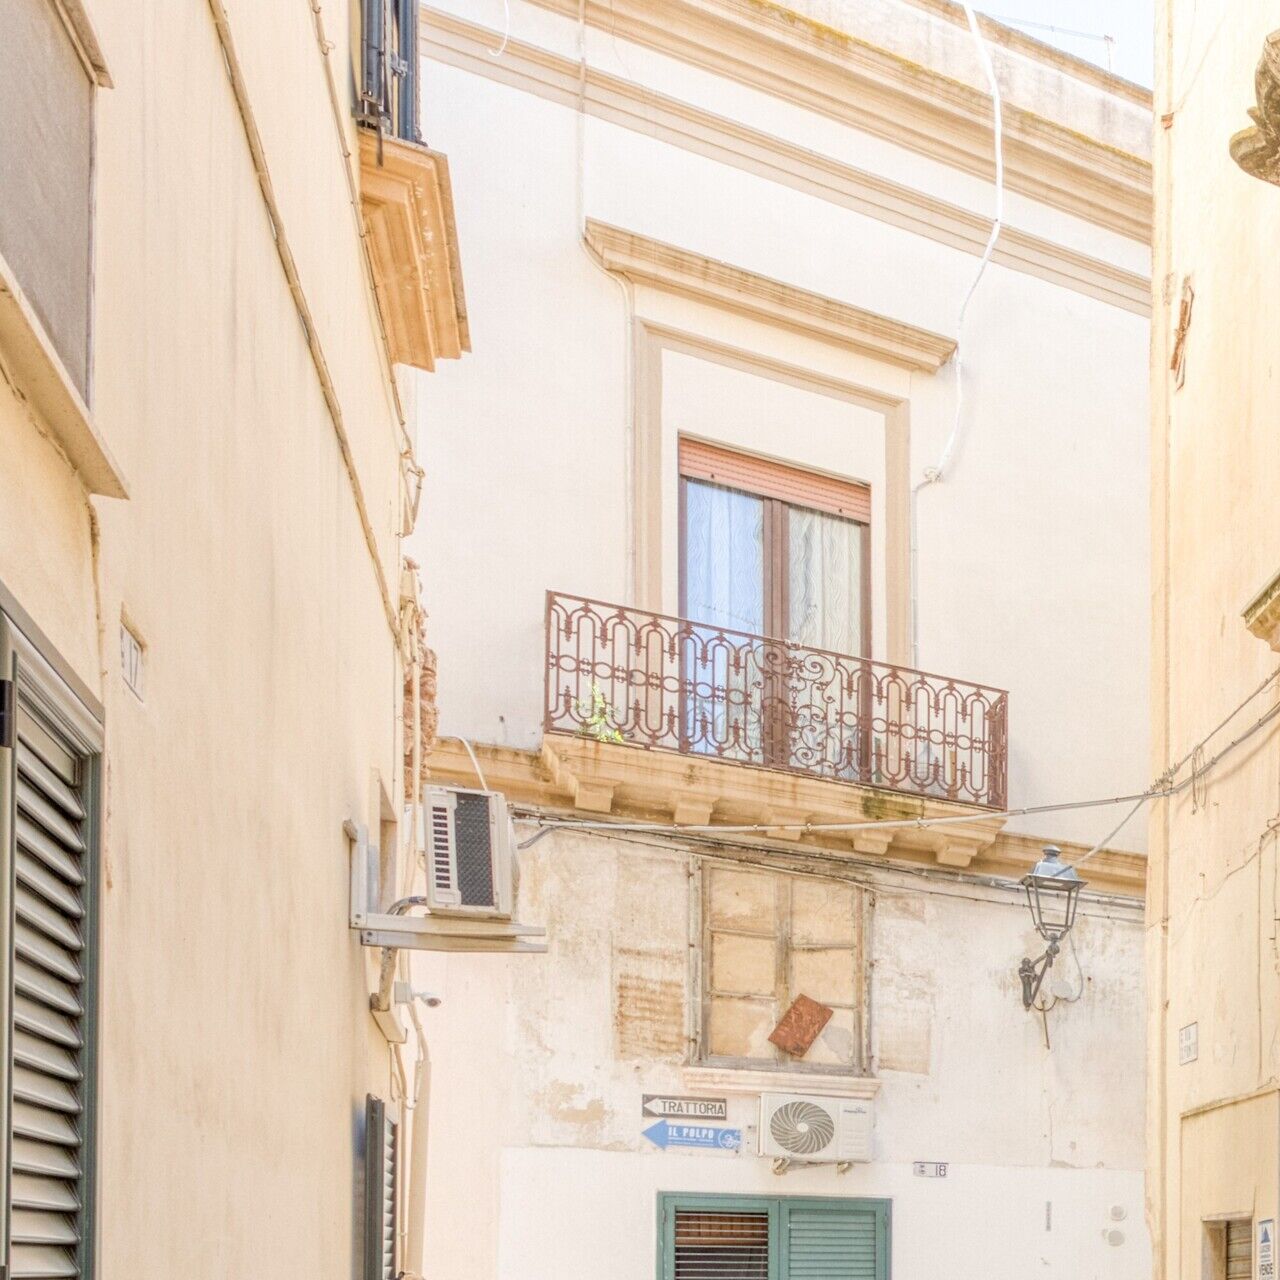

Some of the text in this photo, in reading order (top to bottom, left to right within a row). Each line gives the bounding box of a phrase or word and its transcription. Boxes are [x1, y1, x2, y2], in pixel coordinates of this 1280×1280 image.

[661, 1101, 724, 1115] TRATTORIA
[668, 1127, 714, 1139] IL POLPO
[935, 1164, 946, 1177] 18
